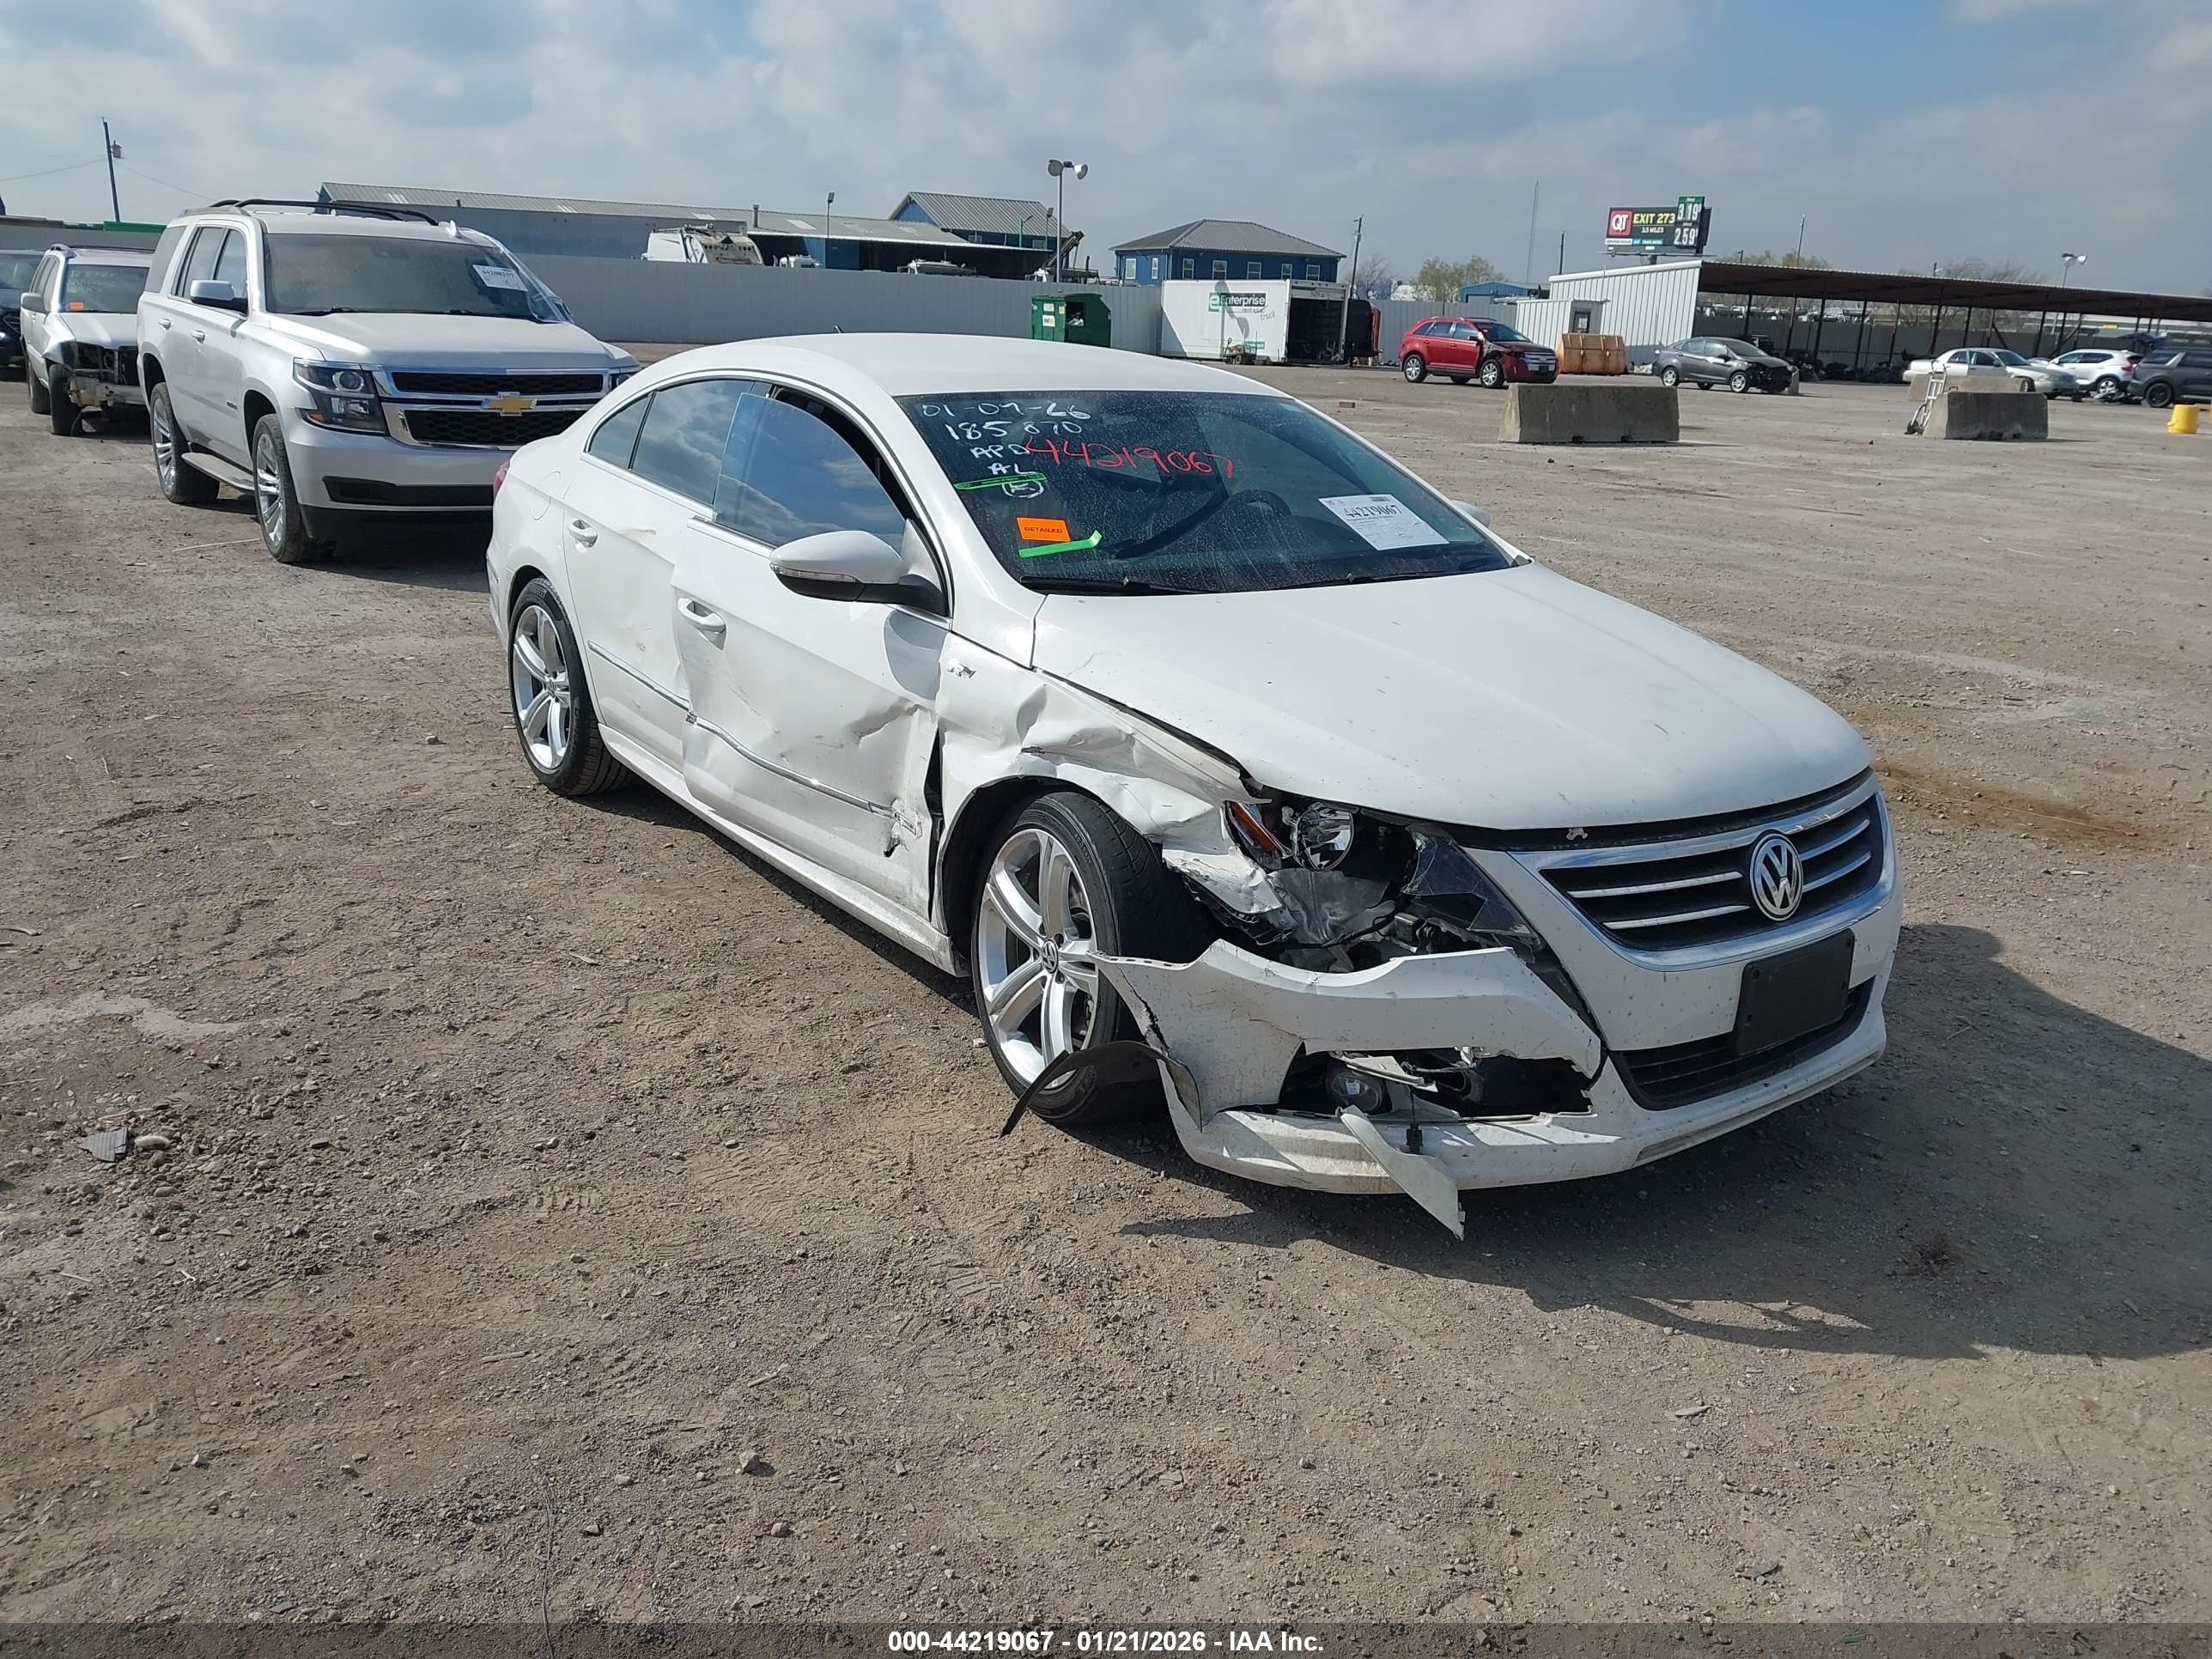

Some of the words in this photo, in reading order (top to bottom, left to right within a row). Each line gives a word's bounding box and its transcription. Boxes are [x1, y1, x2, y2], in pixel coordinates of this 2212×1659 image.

[1612, 214, 1629, 232] QT
[1633, 213, 1656, 224] EXIT
[1657, 212, 1675, 224] 273
[1220, 295, 1266, 308] Enterprise
[1025, 436, 1234, 479] 44219067
[1024, 526, 1064, 534] DETAILED
